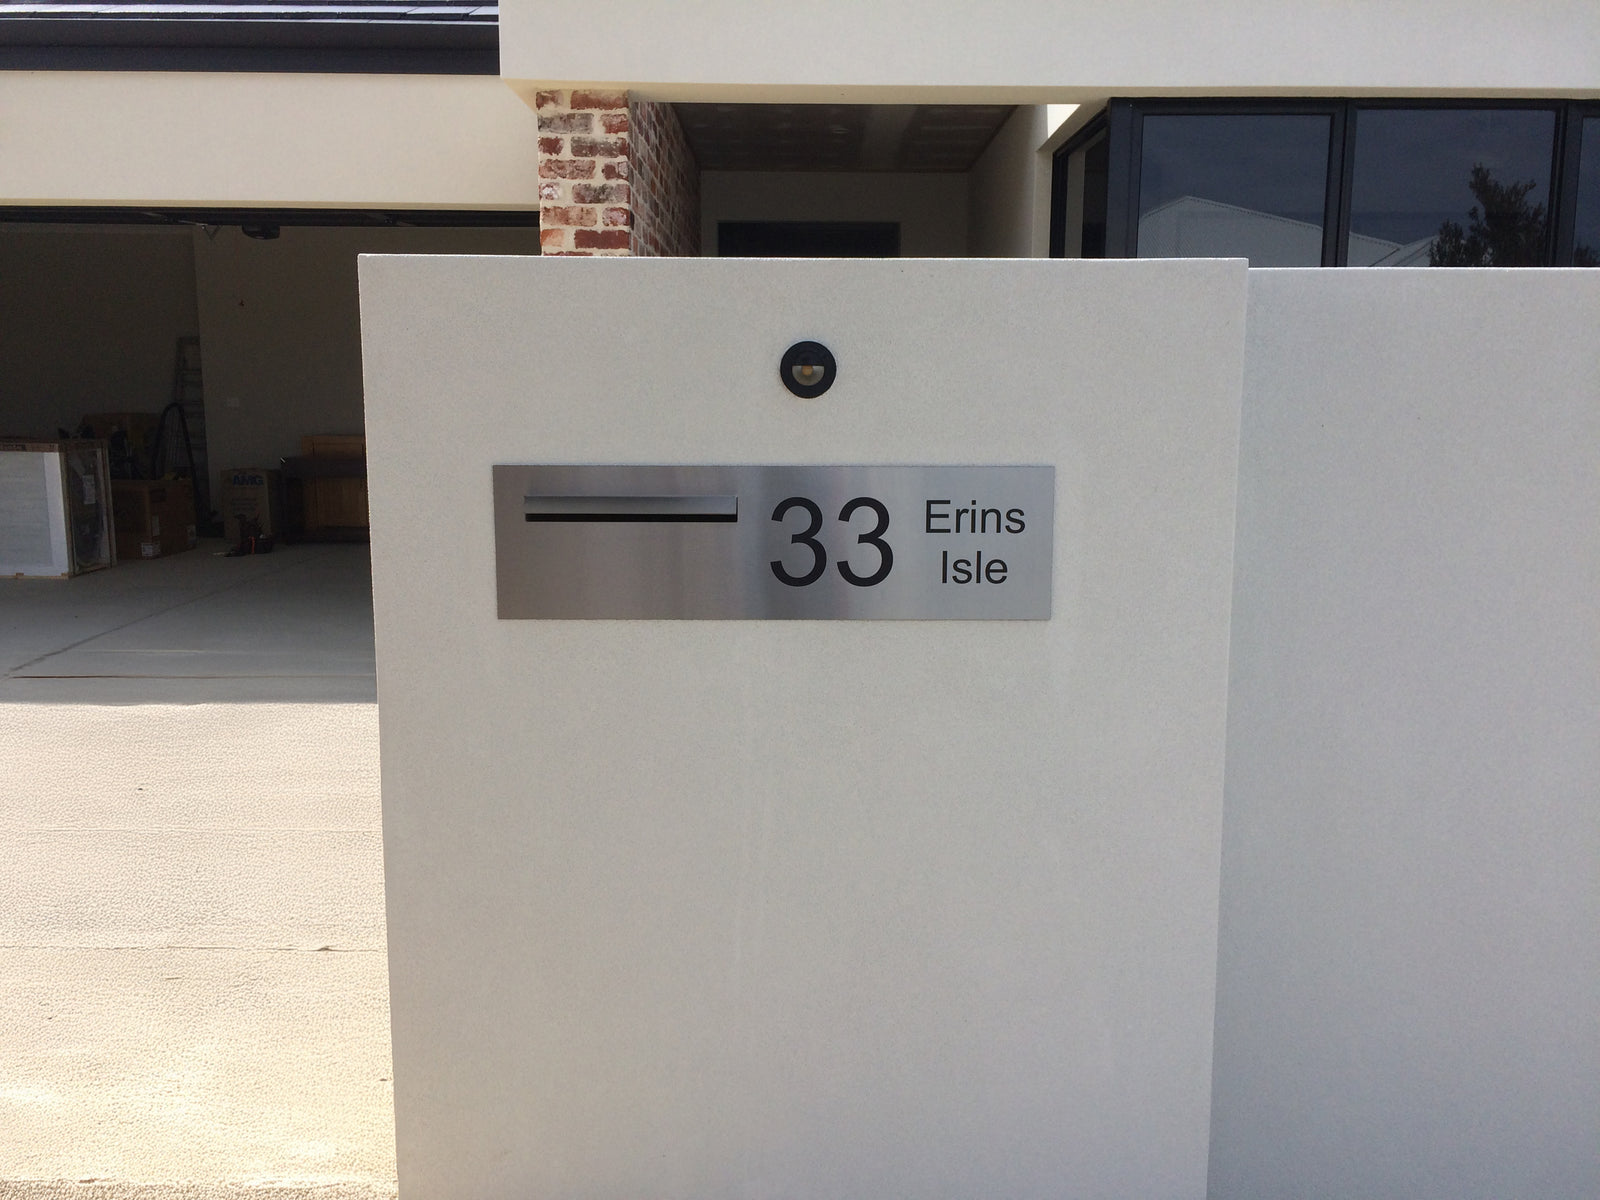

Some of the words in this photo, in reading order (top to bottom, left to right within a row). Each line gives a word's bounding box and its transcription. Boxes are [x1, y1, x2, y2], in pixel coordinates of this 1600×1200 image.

[926, 499, 1026, 535] Erins
[770, 496, 894, 588] 33
[941, 550, 1008, 585] Isle
